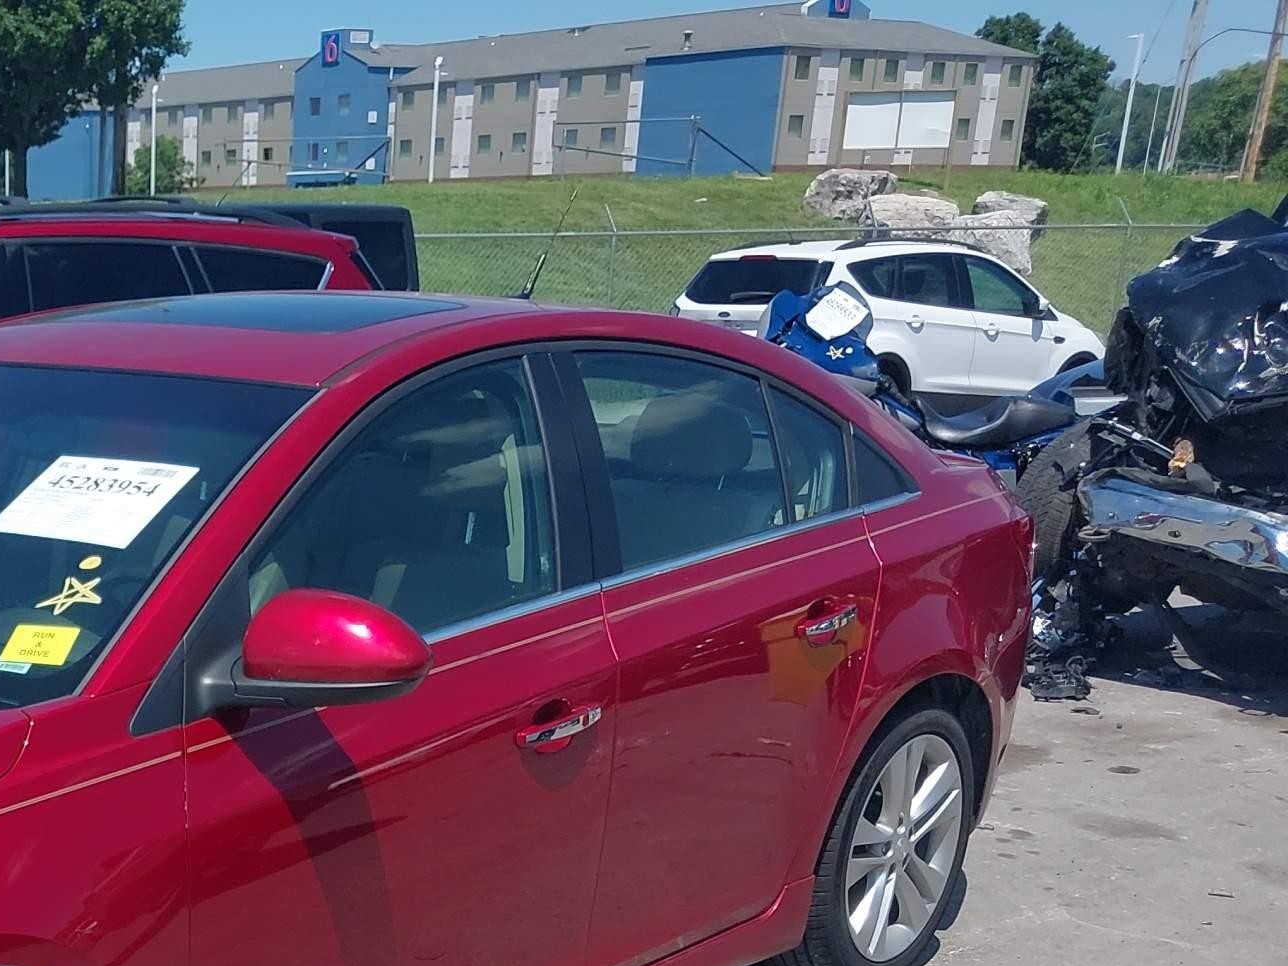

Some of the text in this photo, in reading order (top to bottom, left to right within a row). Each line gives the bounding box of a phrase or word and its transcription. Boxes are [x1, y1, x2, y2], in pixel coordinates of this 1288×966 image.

[325, 34, 338, 63] 6
[48, 475, 161, 496] 45283954
[32, 631, 56, 640] RUN
[18, 649, 50, 658] DRIVE
